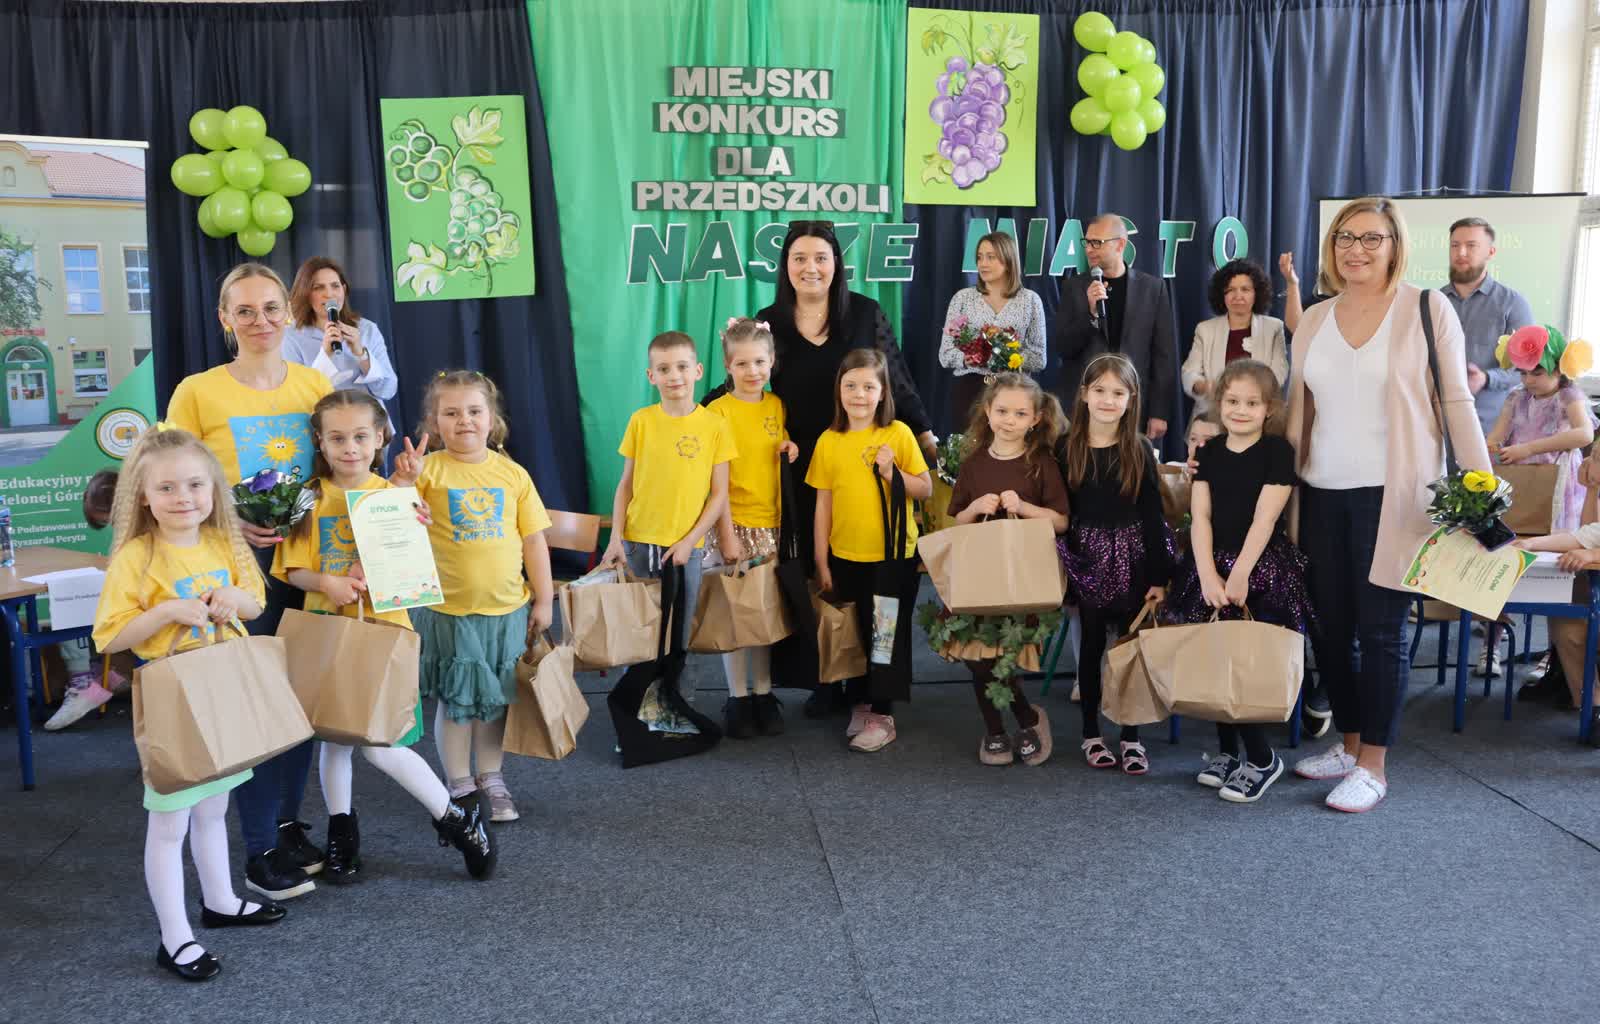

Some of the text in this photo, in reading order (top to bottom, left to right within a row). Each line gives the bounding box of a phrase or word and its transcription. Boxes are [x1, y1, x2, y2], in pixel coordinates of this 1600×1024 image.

[673, 66, 829, 97] MIEJSKI
[659, 103, 839, 137] KONKURS
[717, 147, 792, 176] DLA
[636, 181, 889, 213] PRZEDSZKOLI
[0, 474, 81, 489] Edukacyjny
[2, 491, 51, 505] ielonej
[17, 522, 76, 534] Podstawowa
[56, 534, 87, 544] Peryta
